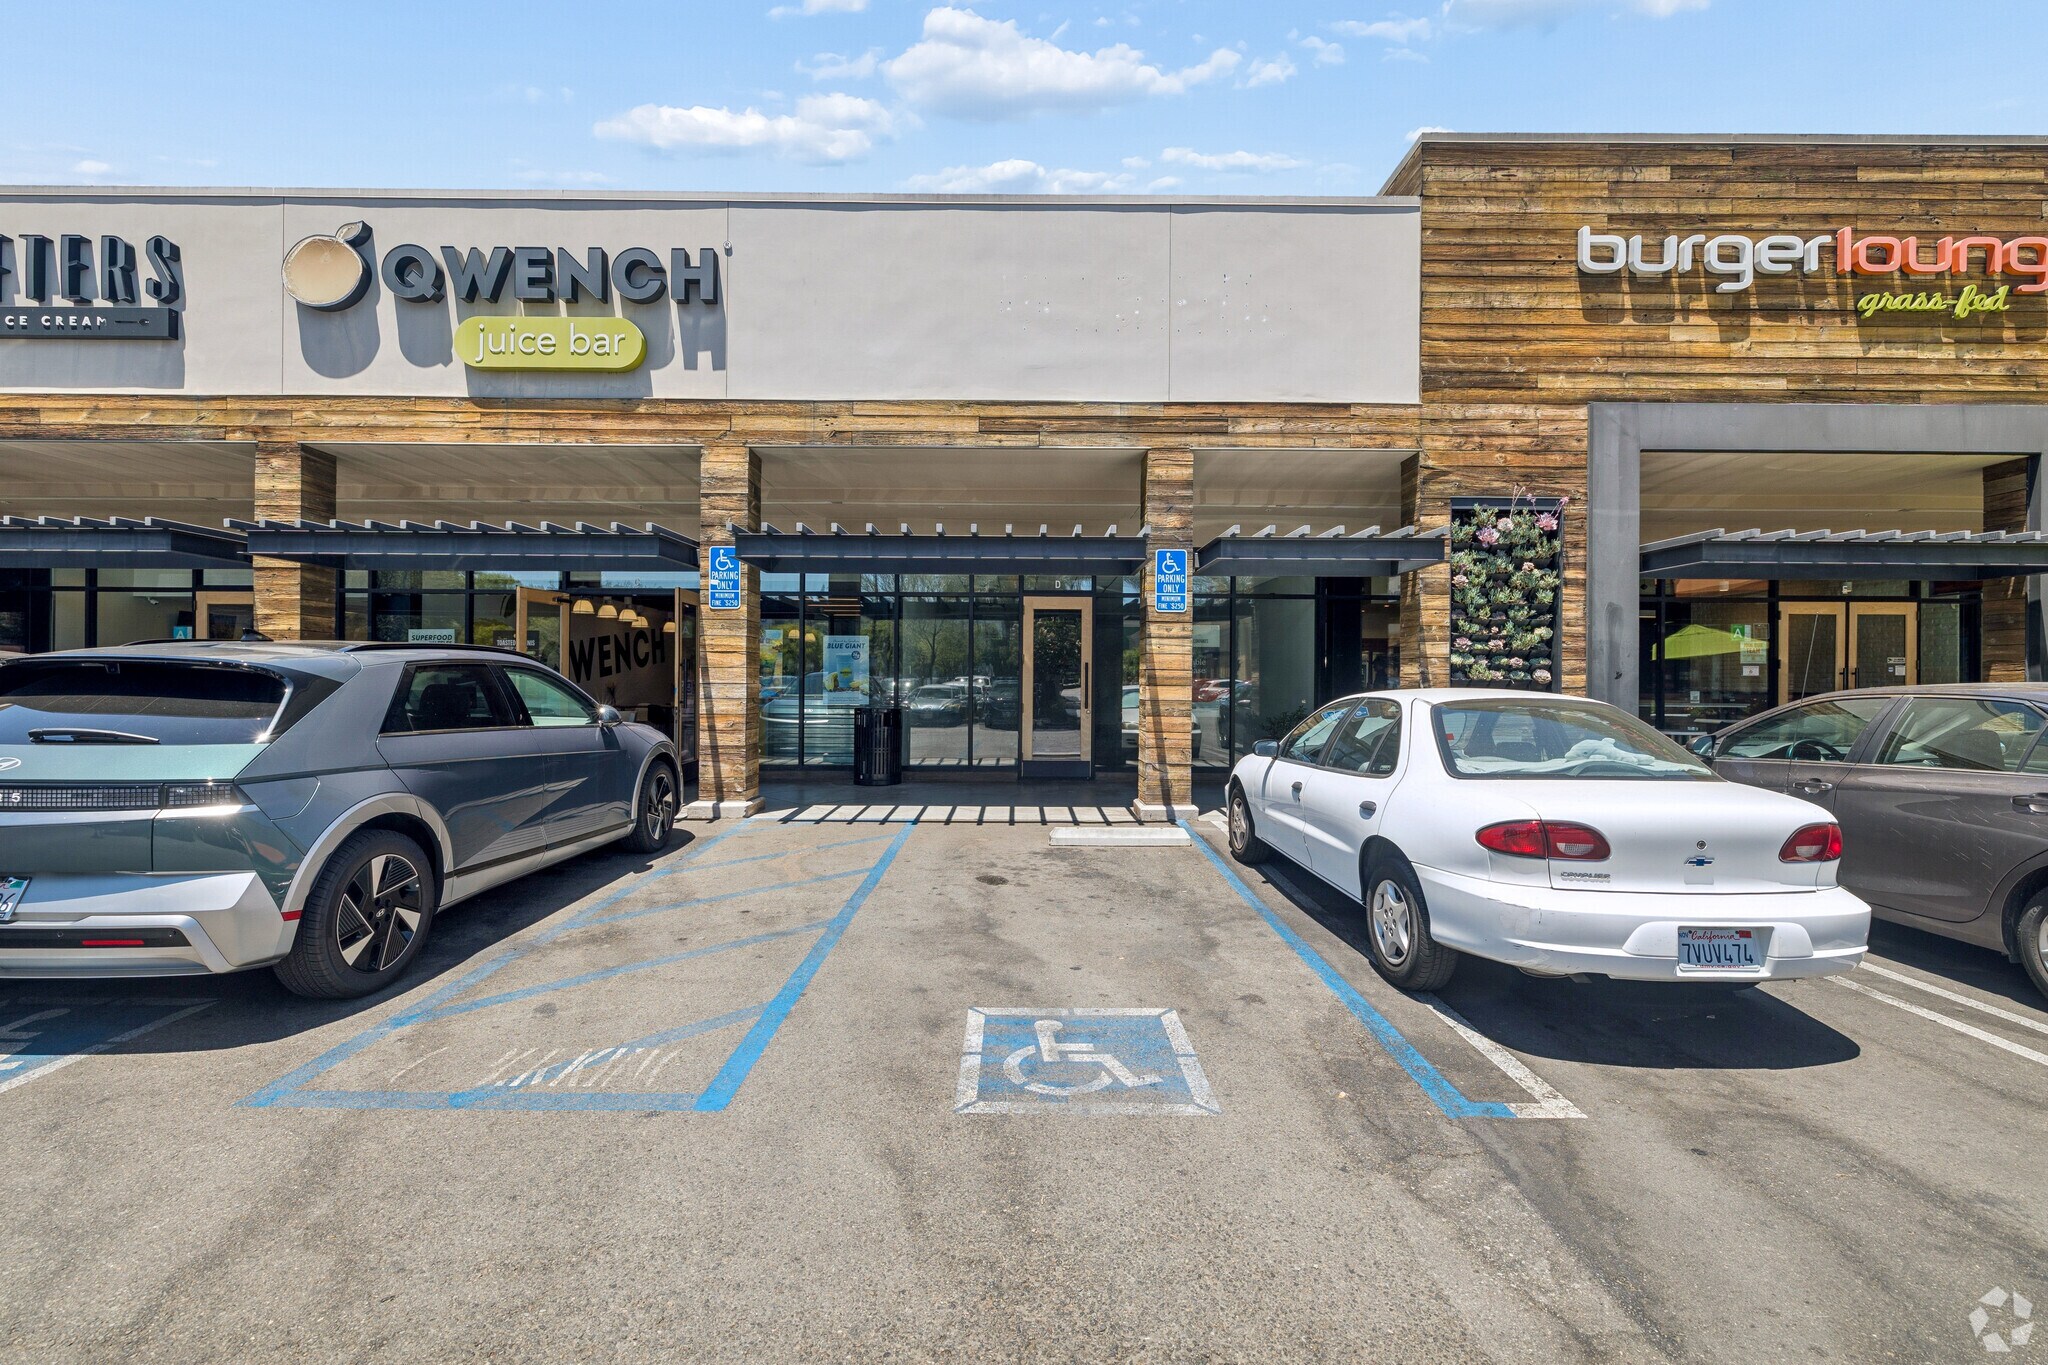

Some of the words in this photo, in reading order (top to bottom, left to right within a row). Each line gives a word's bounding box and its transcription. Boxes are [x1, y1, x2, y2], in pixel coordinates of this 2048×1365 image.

[1577, 225, 1831, 293] burger
[381, 243, 719, 304] QWENCH
[1857, 284, 2010, 319] grass-fed
[41, 315, 107, 326] CREAM
[475, 323, 556, 363] juice
[570, 323, 626, 357] bar
[711, 571, 739, 580] PARKING
[1157, 574, 1185, 584] PARKING
[716, 580, 733, 590] ONLY
[1055, 580, 1061, 589] D
[1162, 584, 1180, 593] ONLY
[1170, 602, 1185, 610] $250
[176, 630, 186, 640] A
[411, 634, 453, 642] SUPERFOOD
[1733, 627, 1743, 639] A
[496, 639, 516, 647] TOASTED
[826, 642, 844, 650] BLUE
[845, 642, 866, 650] GIANT
[11, 792, 21, 803] 5
[1691, 930, 1741, 943] California
[1681, 943, 1754, 964] 7VUV474
